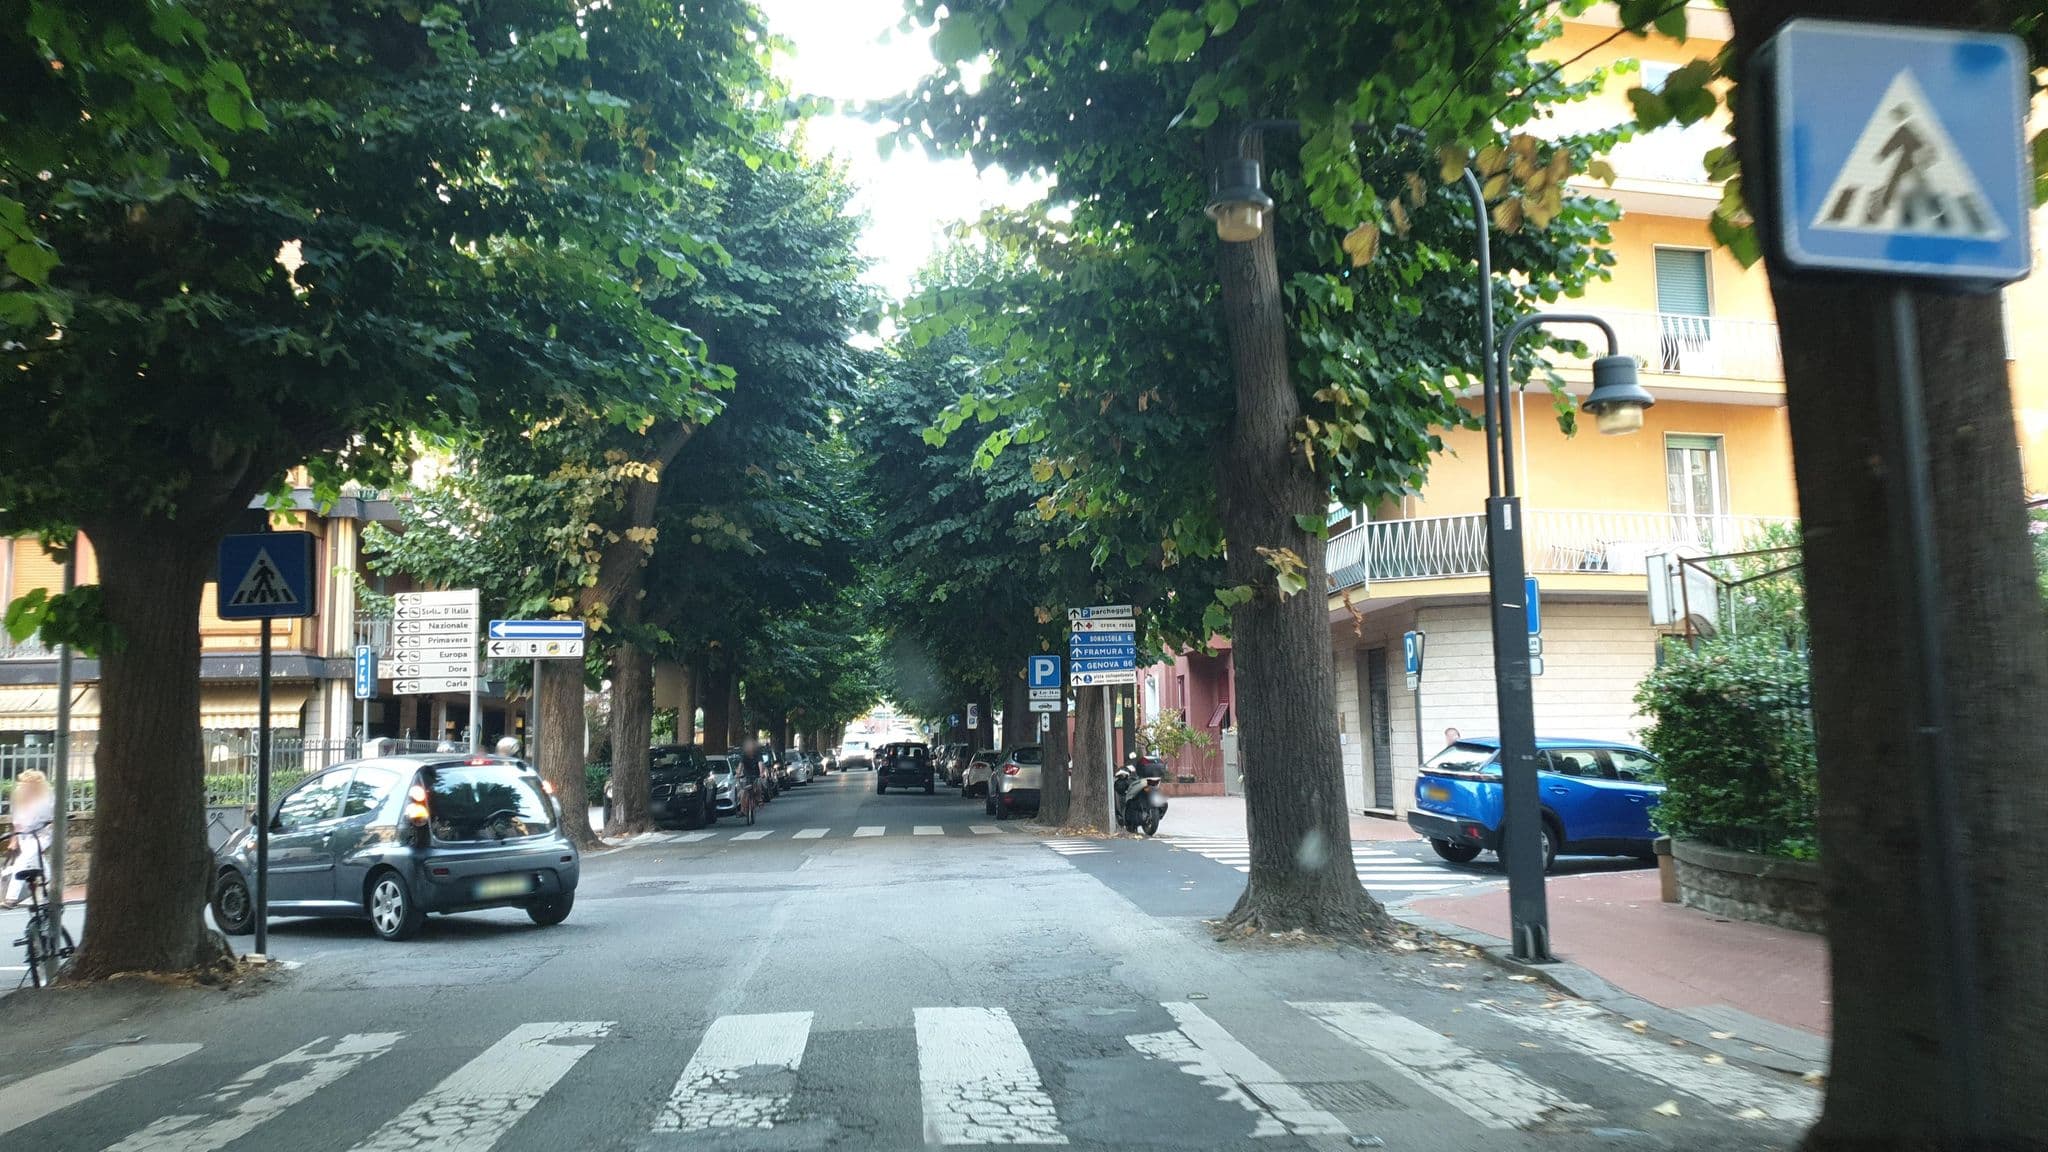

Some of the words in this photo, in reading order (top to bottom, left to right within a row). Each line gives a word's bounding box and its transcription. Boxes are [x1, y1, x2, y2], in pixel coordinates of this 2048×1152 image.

[1091, 608, 1131, 616] parcheggio
[1083, 648, 1123, 656] FRAMURA
[1126, 647, 1135, 655] 12
[1405, 637, 1414, 670] P
[1086, 661, 1120, 669] GENOVA
[1035, 659, 1055, 685] P
